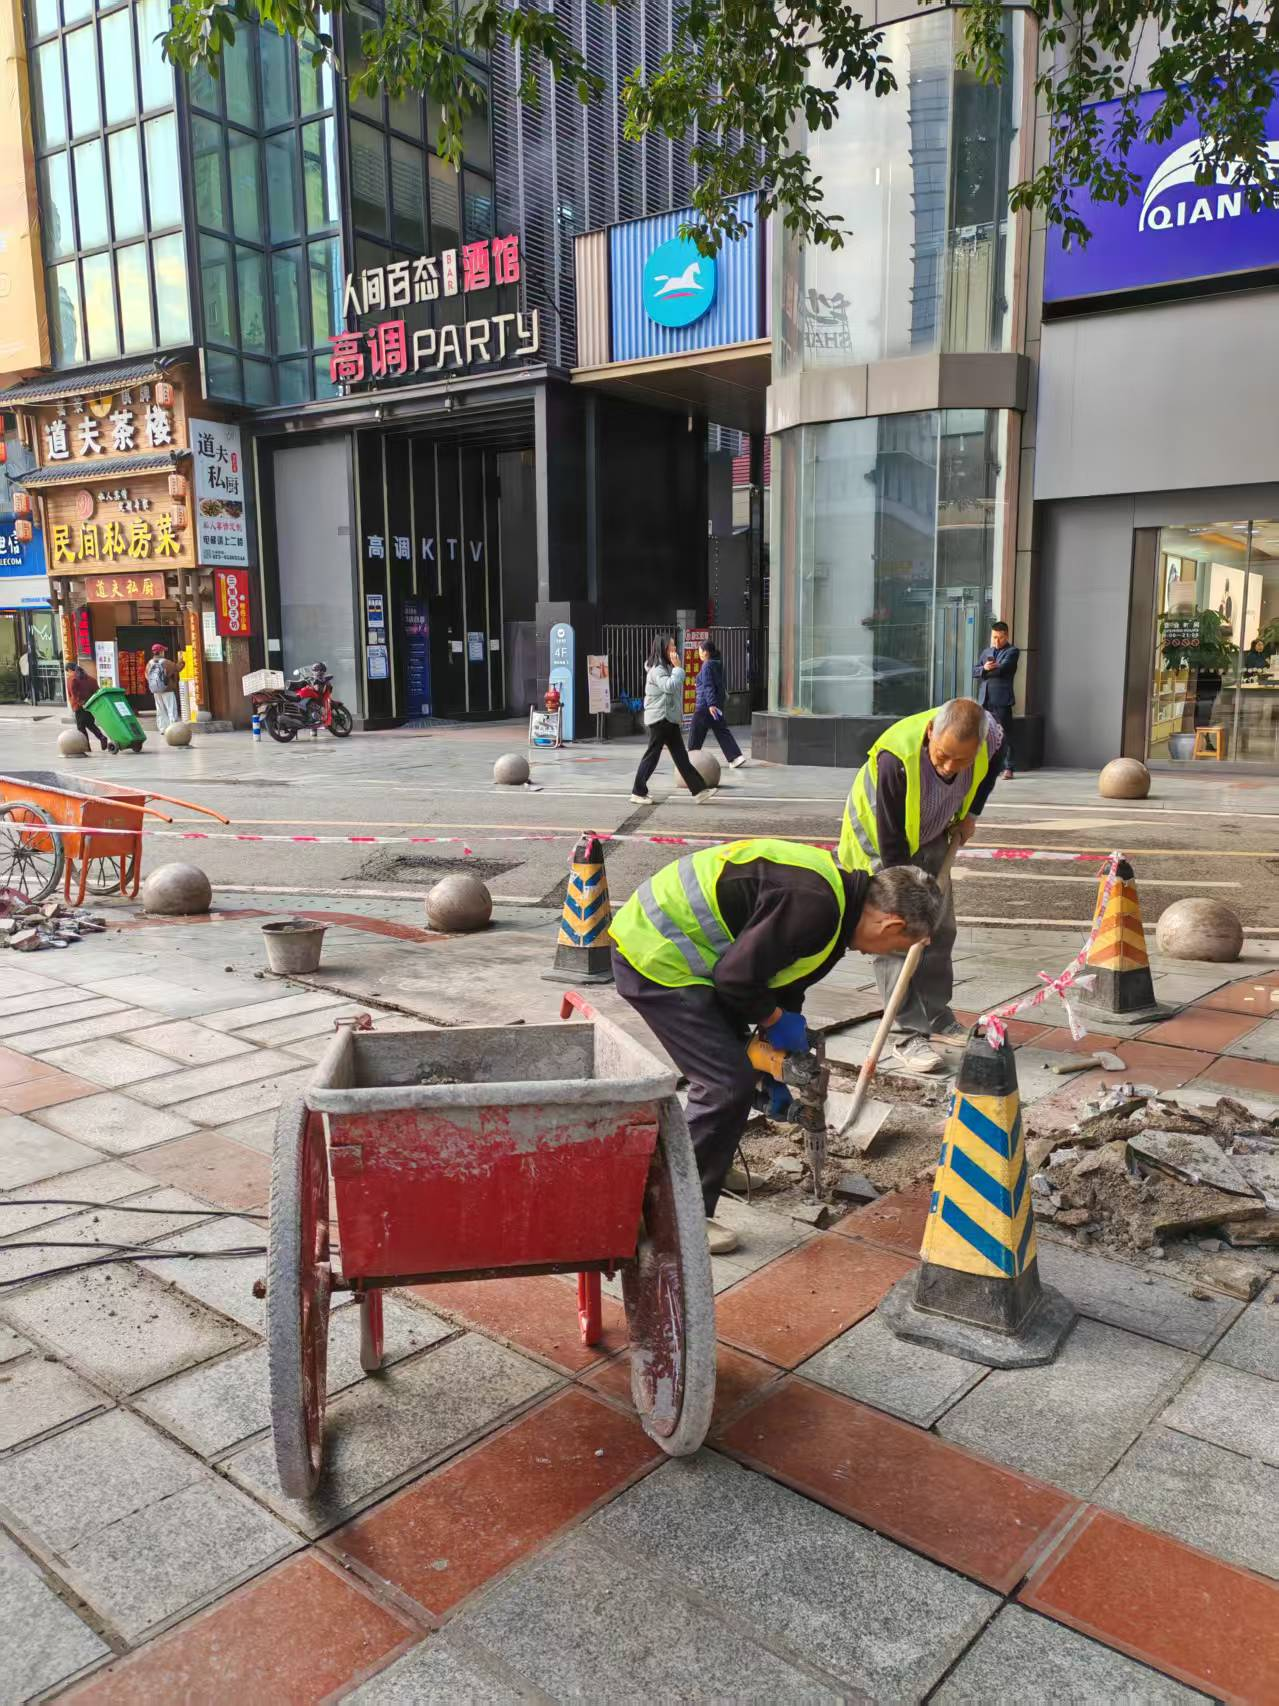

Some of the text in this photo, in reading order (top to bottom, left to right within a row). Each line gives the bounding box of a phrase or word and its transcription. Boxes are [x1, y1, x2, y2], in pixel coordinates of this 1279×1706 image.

[343, 234, 520, 318] 人间百态 BAR 酒馆
[328, 308, 539, 384] 高调 PARTY
[198, 432, 229, 463] 道夫
[208, 465, 240, 495] 私厨
[53, 513, 180, 562] 民间私房菜
[95, 578, 155, 599] 道夫私厨
[554, 647, 568, 658] 4F
